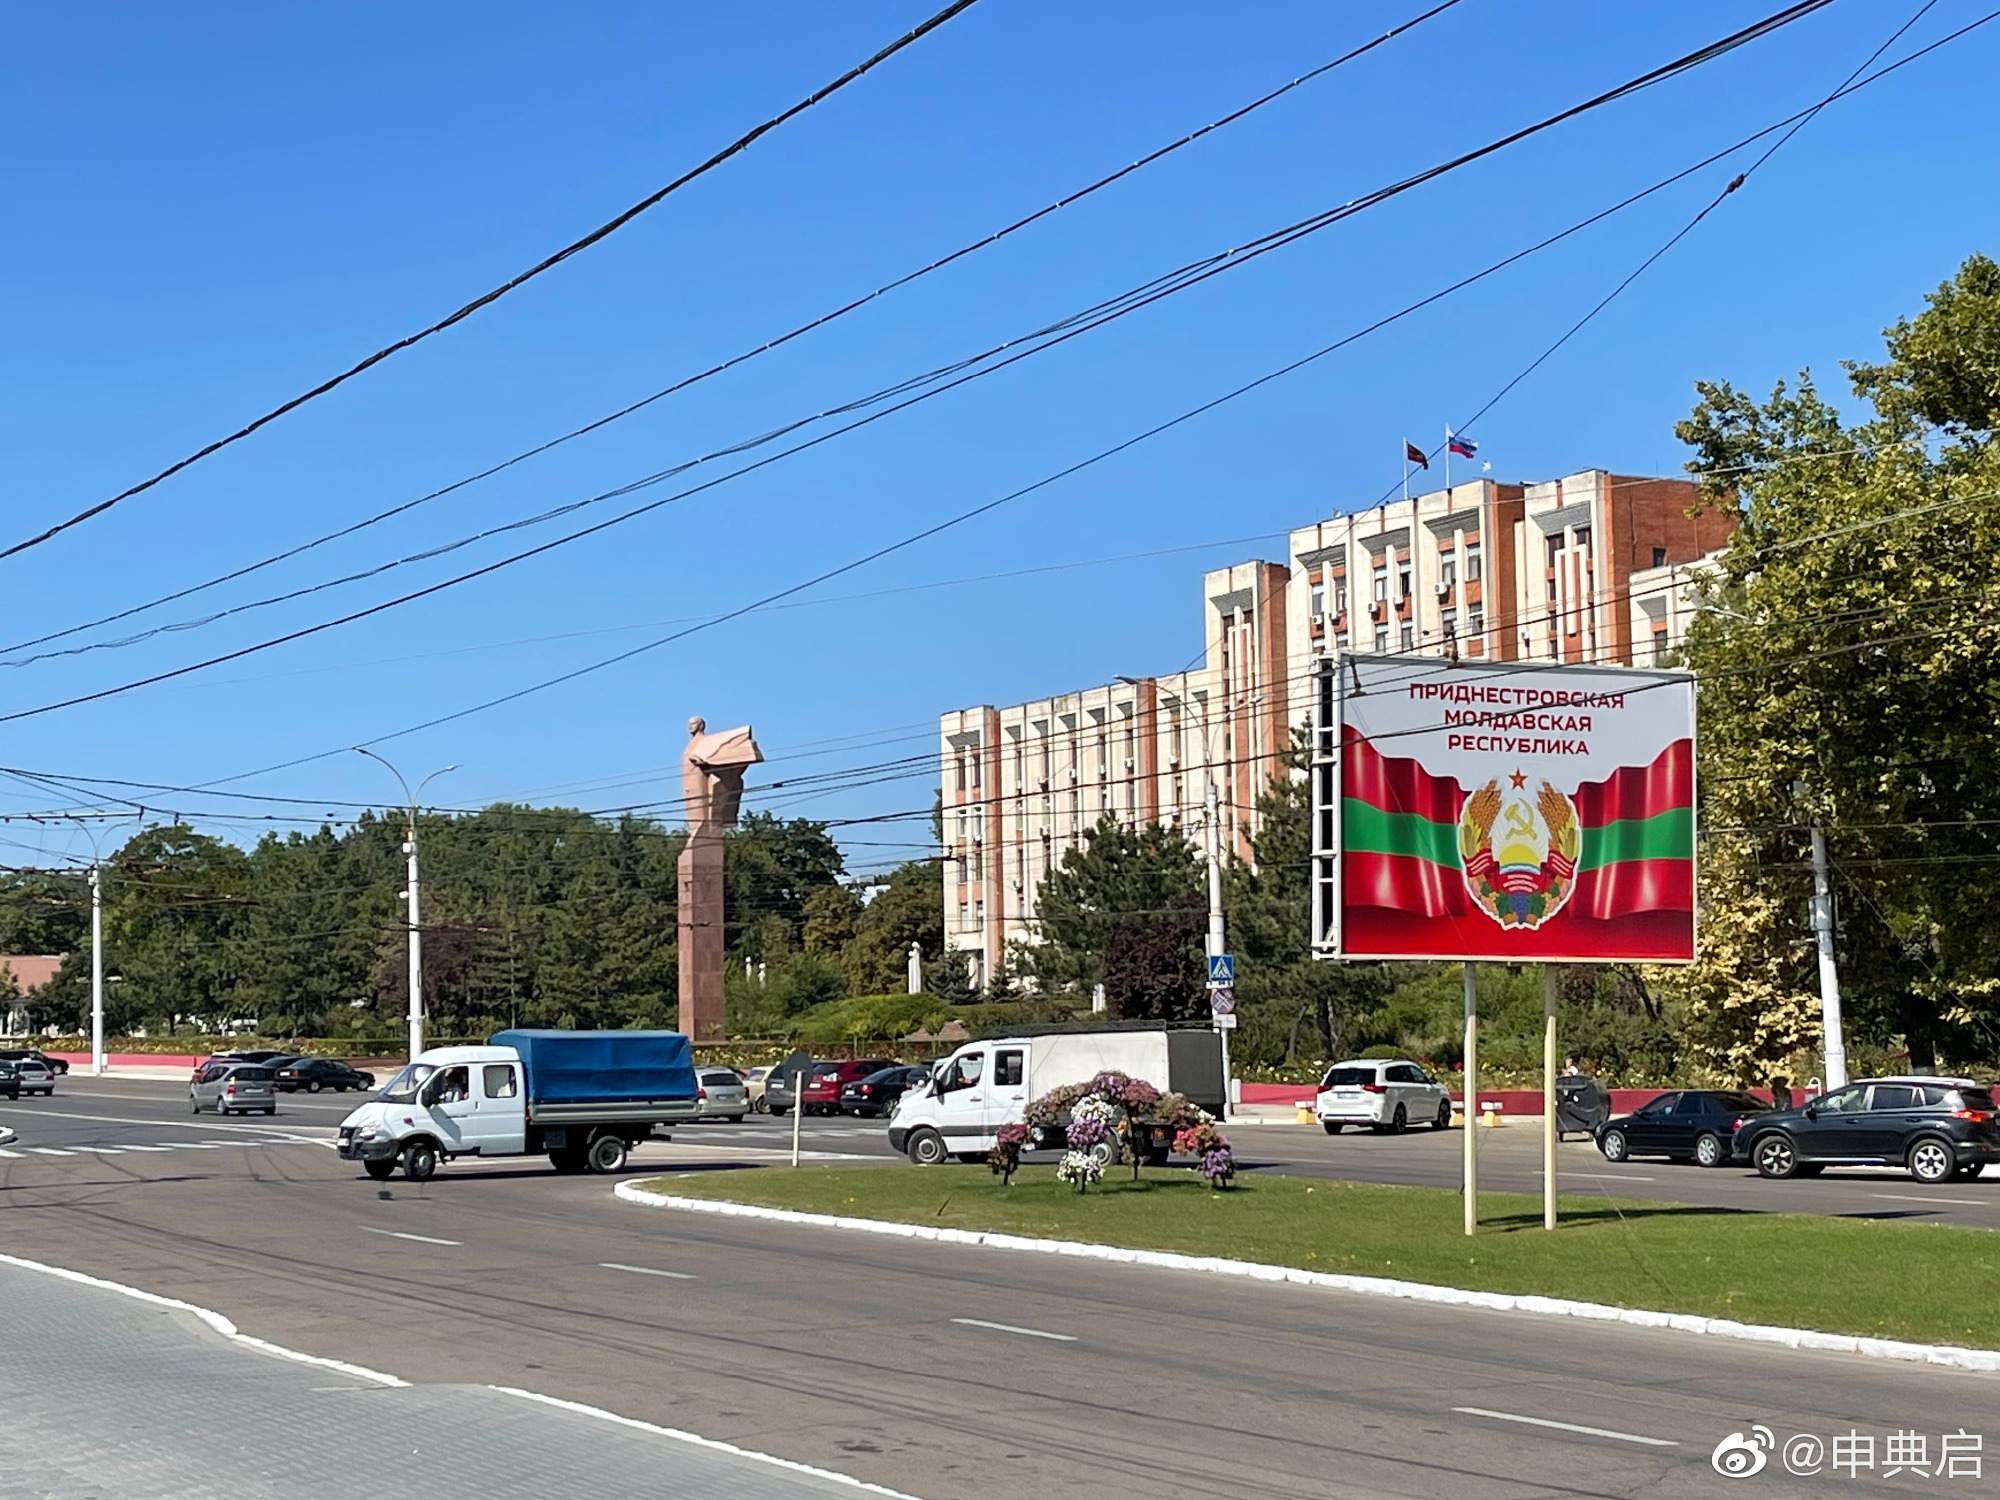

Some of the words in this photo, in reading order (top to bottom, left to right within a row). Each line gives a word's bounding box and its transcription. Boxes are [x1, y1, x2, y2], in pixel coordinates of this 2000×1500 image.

[1410, 683, 1624, 709] ПРИДНЕСТРОВСКАЯ
[1444, 709, 1592, 732] МОЛДАВСКАЯ
[1448, 734, 1589, 755] РЕСПУБЛИКА
